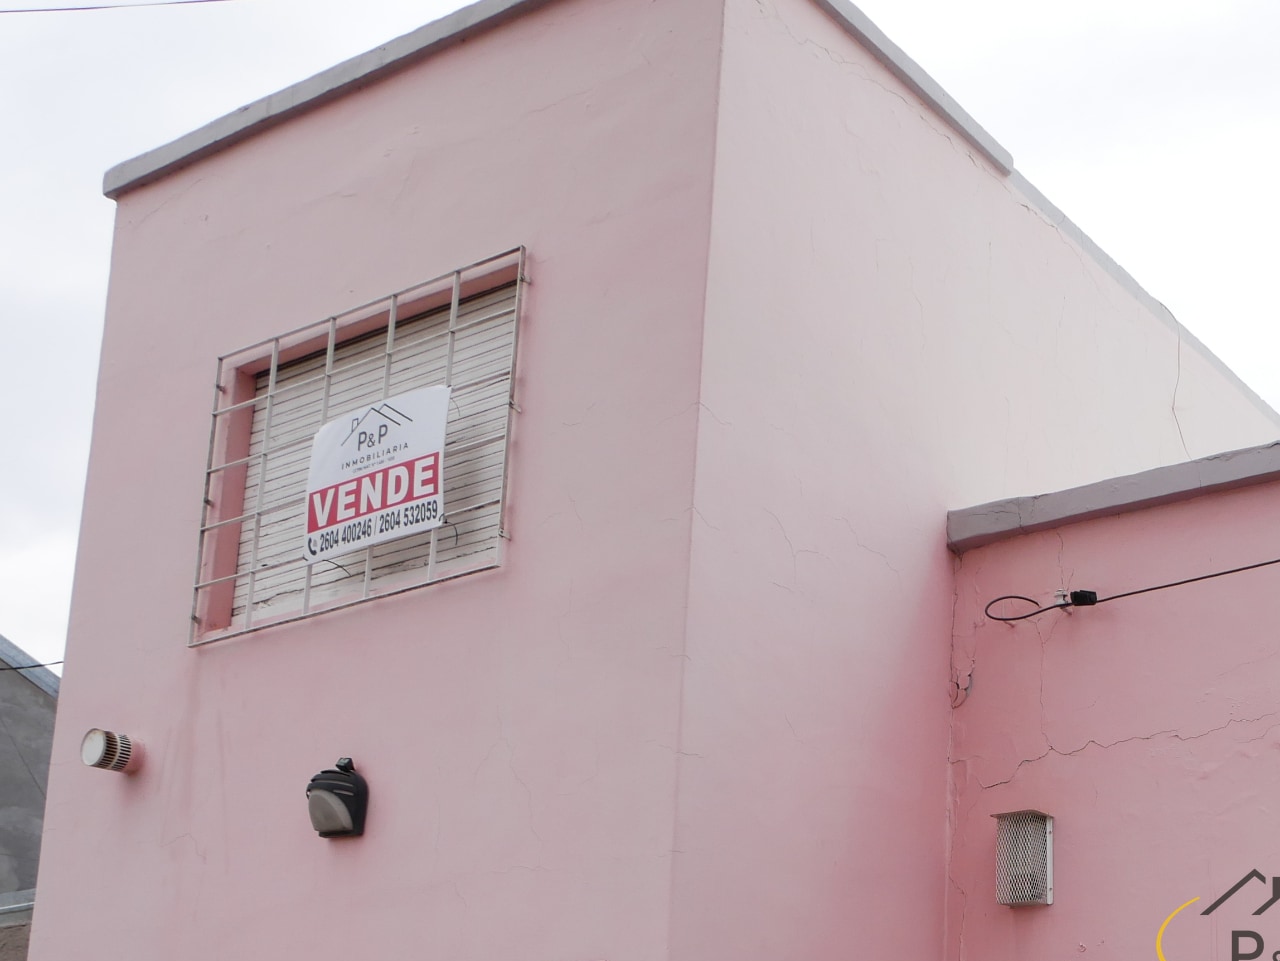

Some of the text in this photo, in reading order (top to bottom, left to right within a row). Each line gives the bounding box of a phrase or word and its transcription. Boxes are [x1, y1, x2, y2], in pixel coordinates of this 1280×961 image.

[341, 442, 409, 470] INMOBILIARIA
[357, 424, 388, 451] P&P
[313, 456, 435, 528] VENDE
[319, 528, 340, 553] 2604
[341, 518, 372, 546] 400246
[379, 509, 401, 533] 2604
[403, 499, 438, 527] 532059
